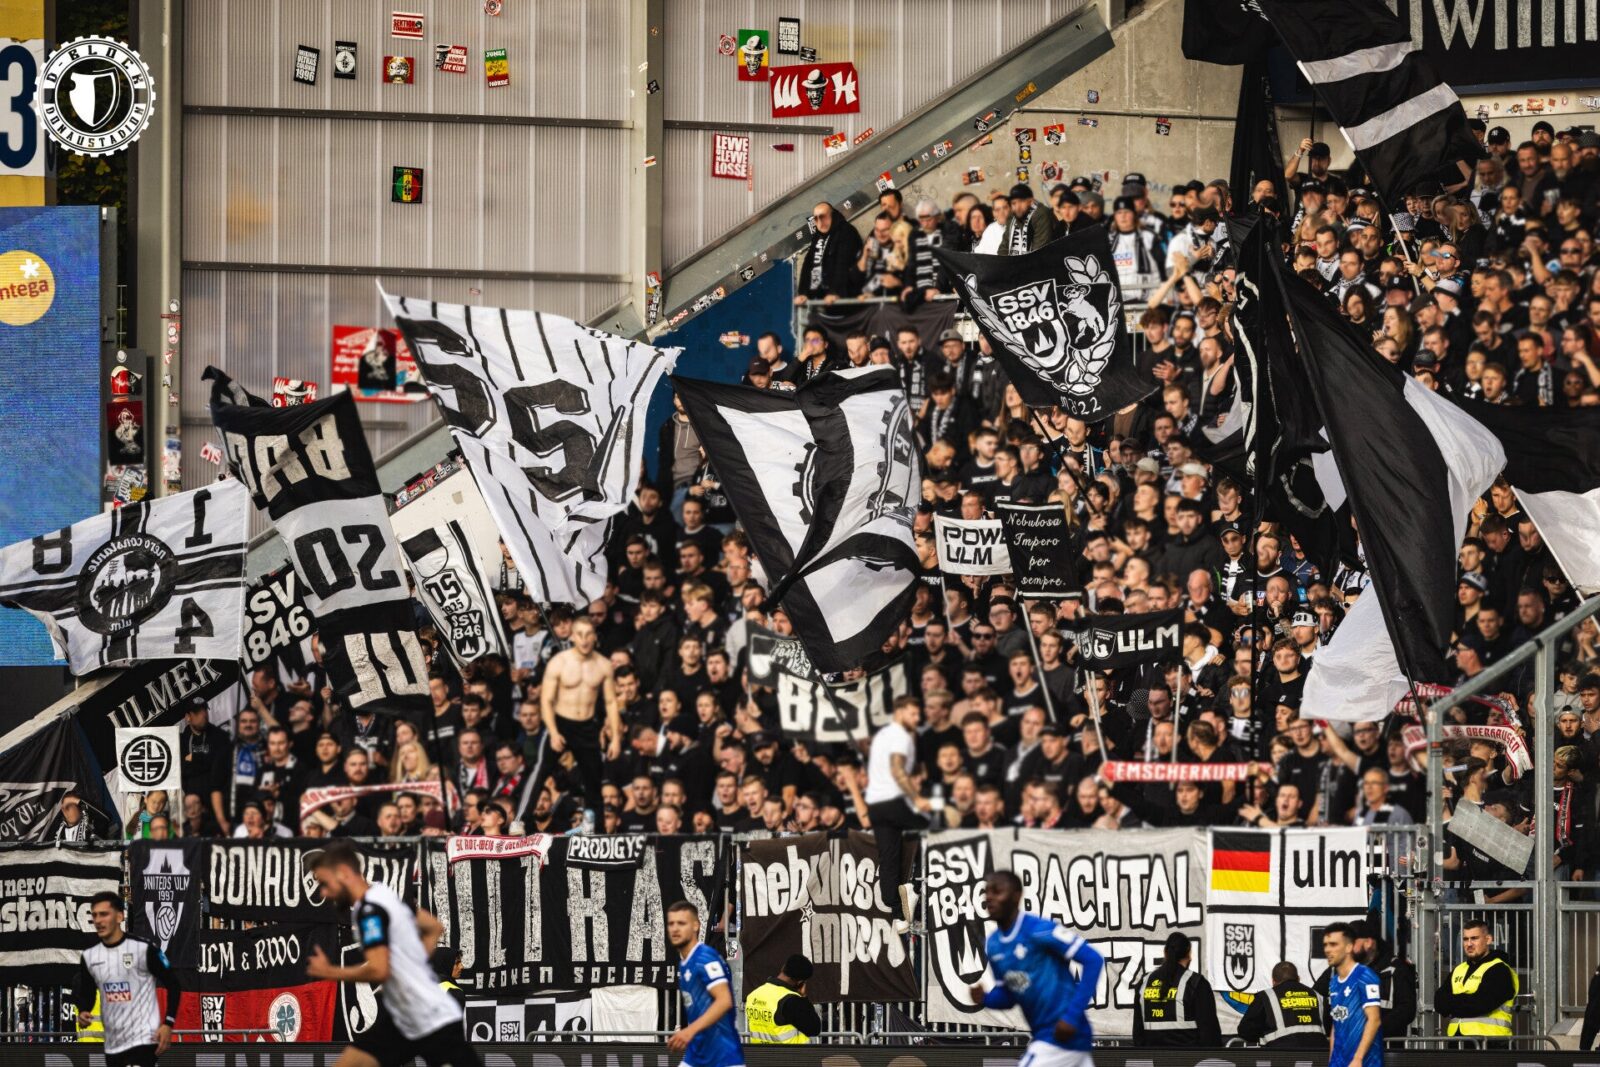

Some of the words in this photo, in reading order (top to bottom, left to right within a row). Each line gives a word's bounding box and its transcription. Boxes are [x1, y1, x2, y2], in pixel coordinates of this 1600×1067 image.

[779, 40, 799, 51] 1996
[295, 68, 315, 82] 1996
[715, 162, 748, 177] LOSSE
[997, 282, 1051, 314] SSV
[1003, 301, 1055, 333] 1846
[1006, 513, 1062, 527] Nebulosa
[1013, 533, 1060, 550] Impero
[946, 544, 993, 565] ULM
[1029, 558, 1051, 573] per
[1020, 576, 1067, 591] sempre.
[451, 612, 481, 628] SSV
[1117, 623, 1180, 653] ULM
[107, 659, 222, 729] ULMER
[569, 835, 645, 861] PRODIGYS
[928, 842, 988, 888] SSV
[1293, 835, 1362, 888] ulm
[144, 876, 172, 891] UNITEDS
[174, 876, 191, 891] ULM
[210, 845, 301, 907] DONAU
[158, 891, 175, 901] 1997
[1012, 850, 1203, 931] BACHTAL
[1225, 924, 1253, 941] SSV
[255, 933, 301, 971] RWO
[1226, 940, 1253, 957] 1846
[475, 966, 554, 990] BROKEN
[573, 964, 677, 985] SOCIETY
[106, 991, 132, 1002] MOLY
[202, 996, 224, 1010] SSV
[1280, 996, 1318, 1008] SECURITY
[203, 1009, 222, 1023] 1846
[1151, 1009, 1164, 1018] 708
[1297, 1015, 1313, 1023] 709
[500, 1021, 520, 1034] SSV
